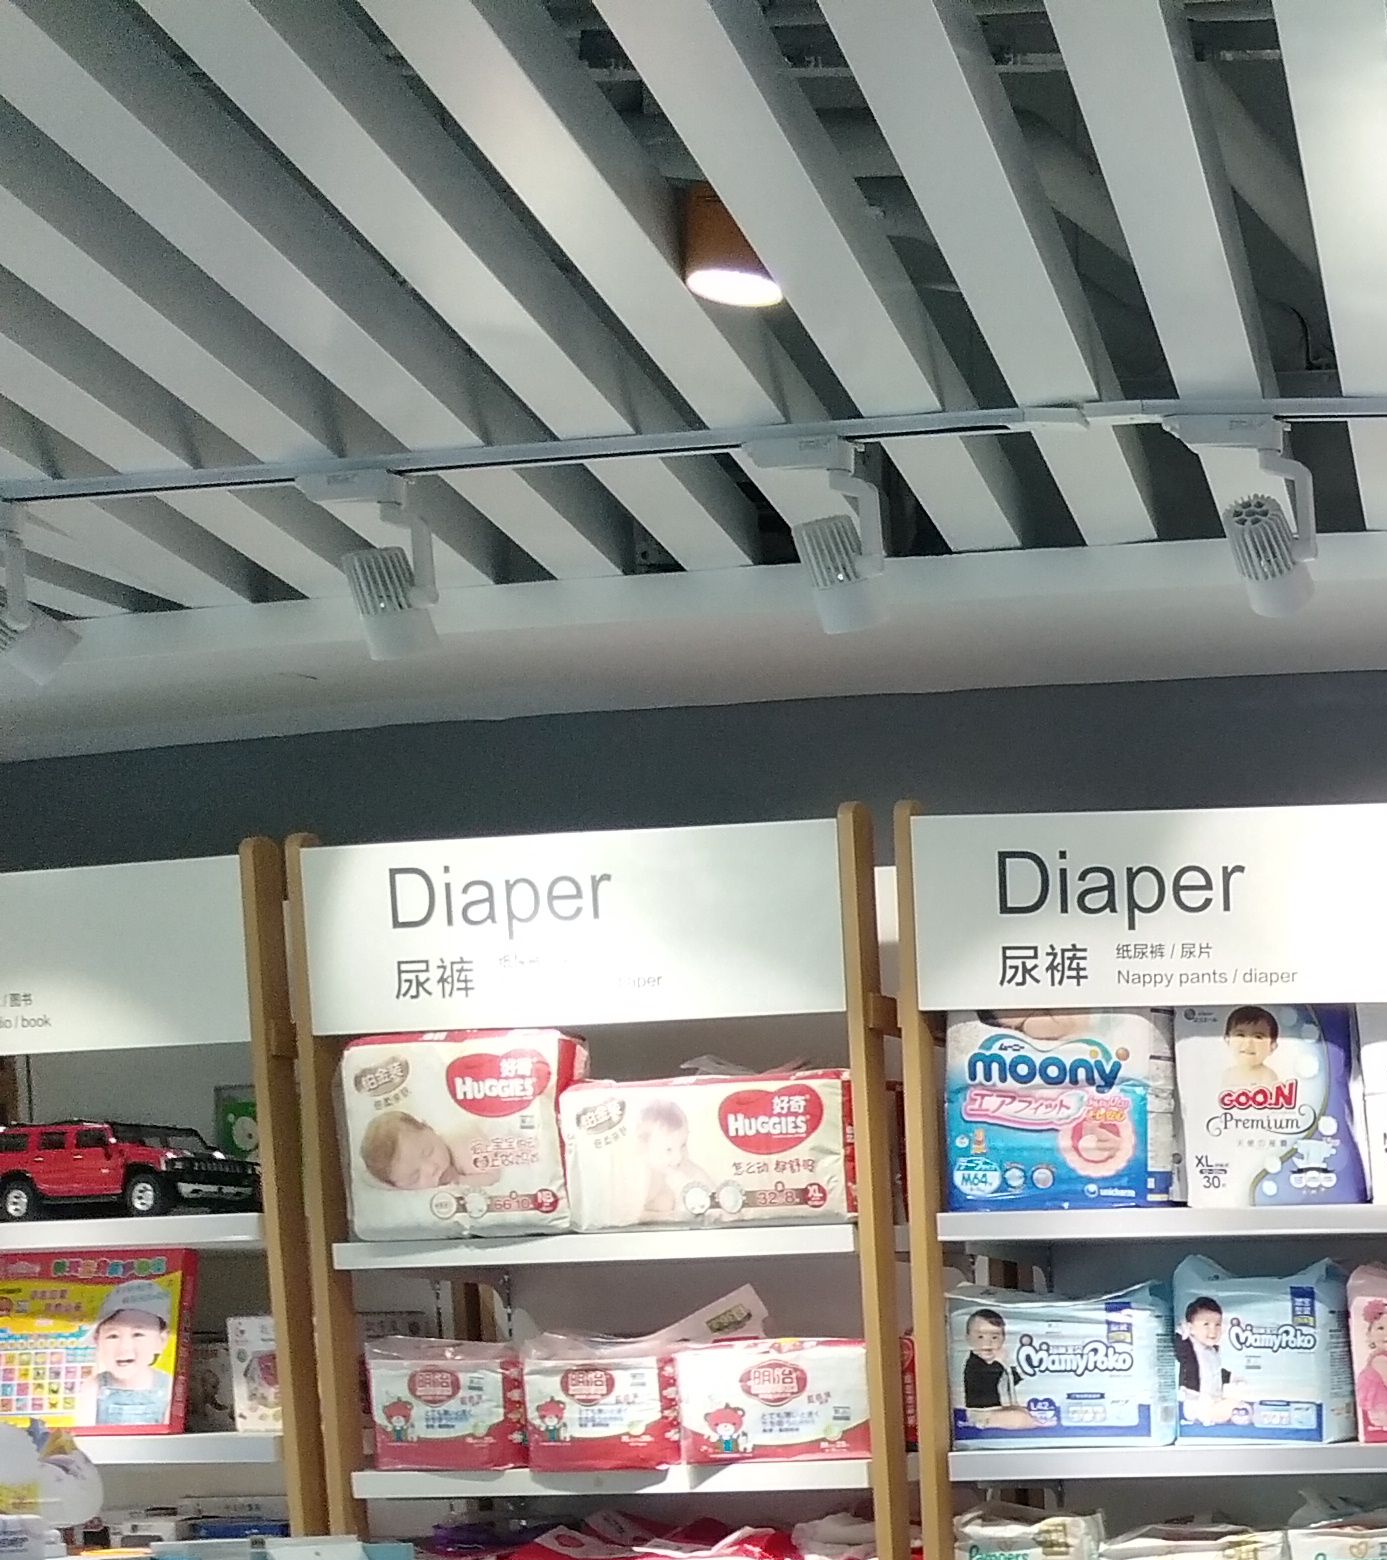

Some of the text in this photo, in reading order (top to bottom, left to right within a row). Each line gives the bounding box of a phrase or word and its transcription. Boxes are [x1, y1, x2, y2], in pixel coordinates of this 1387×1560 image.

[997, 849, 1245, 930] Diaper
[389, 865, 611, 940] Diaper
[1116, 943, 1165, 960] 纸尿裤
[1180, 942, 1213, 960] 尿片
[395, 957, 475, 1000] 尿裤
[998, 945, 1089, 988] 尿裤
[1117, 969, 1174, 988] Nappy
[1179, 968, 1230, 987] pants
[1242, 967, 1298, 986] diaper
[21, 1014, 52, 1029] book
[968, 1052, 1122, 1094] moony
[455, 1077, 534, 1099] HUGGIES
[772, 1096, 806, 1114] 好奇
[727, 1113, 807, 1137] HUGGIES
[1214, 1110, 1308, 1134] Premium
[1195, 1155, 1213, 1168] XL
[1229, 1318, 1316, 1351] MamyPoko
[1017, 1334, 1133, 1376] MamyPoko
